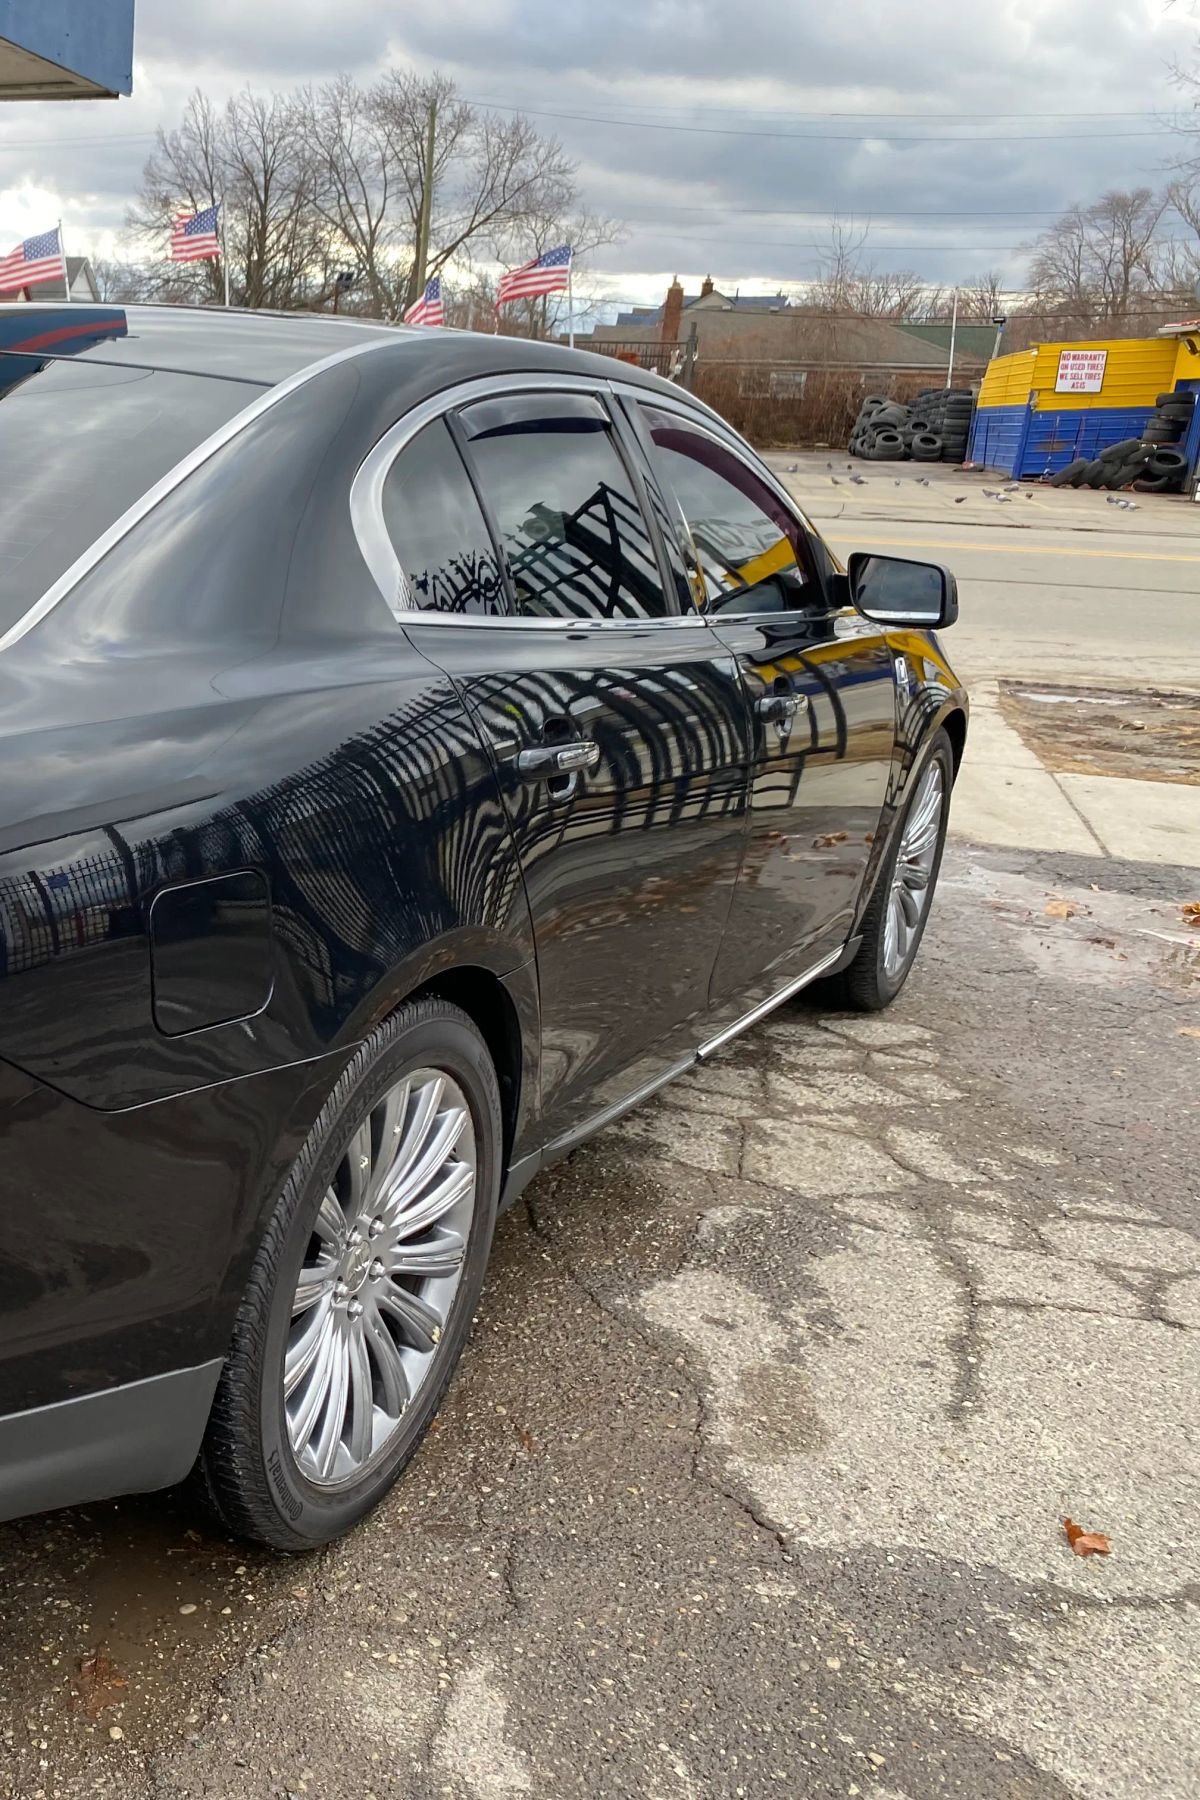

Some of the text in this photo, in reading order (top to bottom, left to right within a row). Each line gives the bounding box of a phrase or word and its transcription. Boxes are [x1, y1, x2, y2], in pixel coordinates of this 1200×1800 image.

[1061, 353, 1105, 361] NO WARRANTY
[1060, 363, 1104, 371] ON USED TIRES
[1059, 372, 1101, 380] WE SELL TIRES
[269, 1459, 304, 1521] Continental
